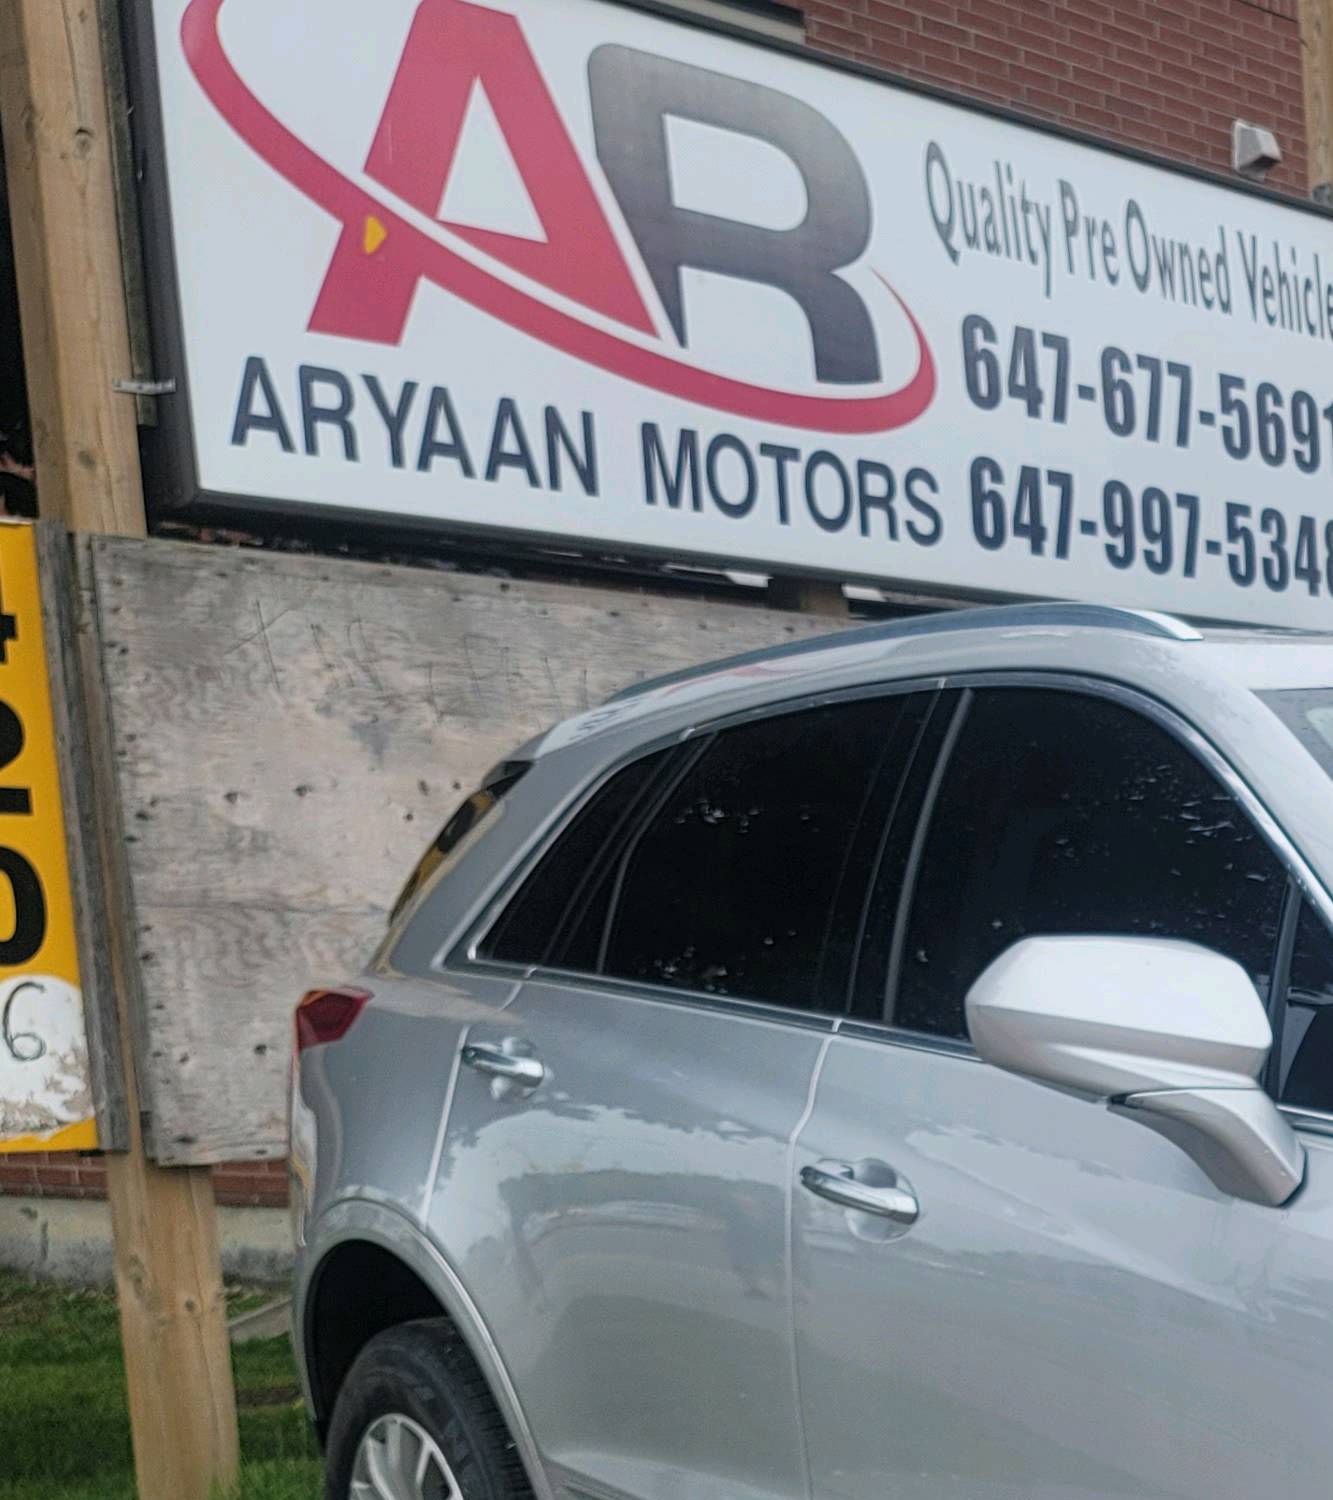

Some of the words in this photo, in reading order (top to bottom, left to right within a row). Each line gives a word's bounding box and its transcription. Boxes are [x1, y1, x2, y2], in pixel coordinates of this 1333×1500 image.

[924, 140, 1052, 299] Quality
[1058, 178, 1120, 286] Pre
[1124, 198, 1234, 316] Owned
[229, 355, 601, 499] ARYAAN
[639, 420, 945, 548] MOTORS
